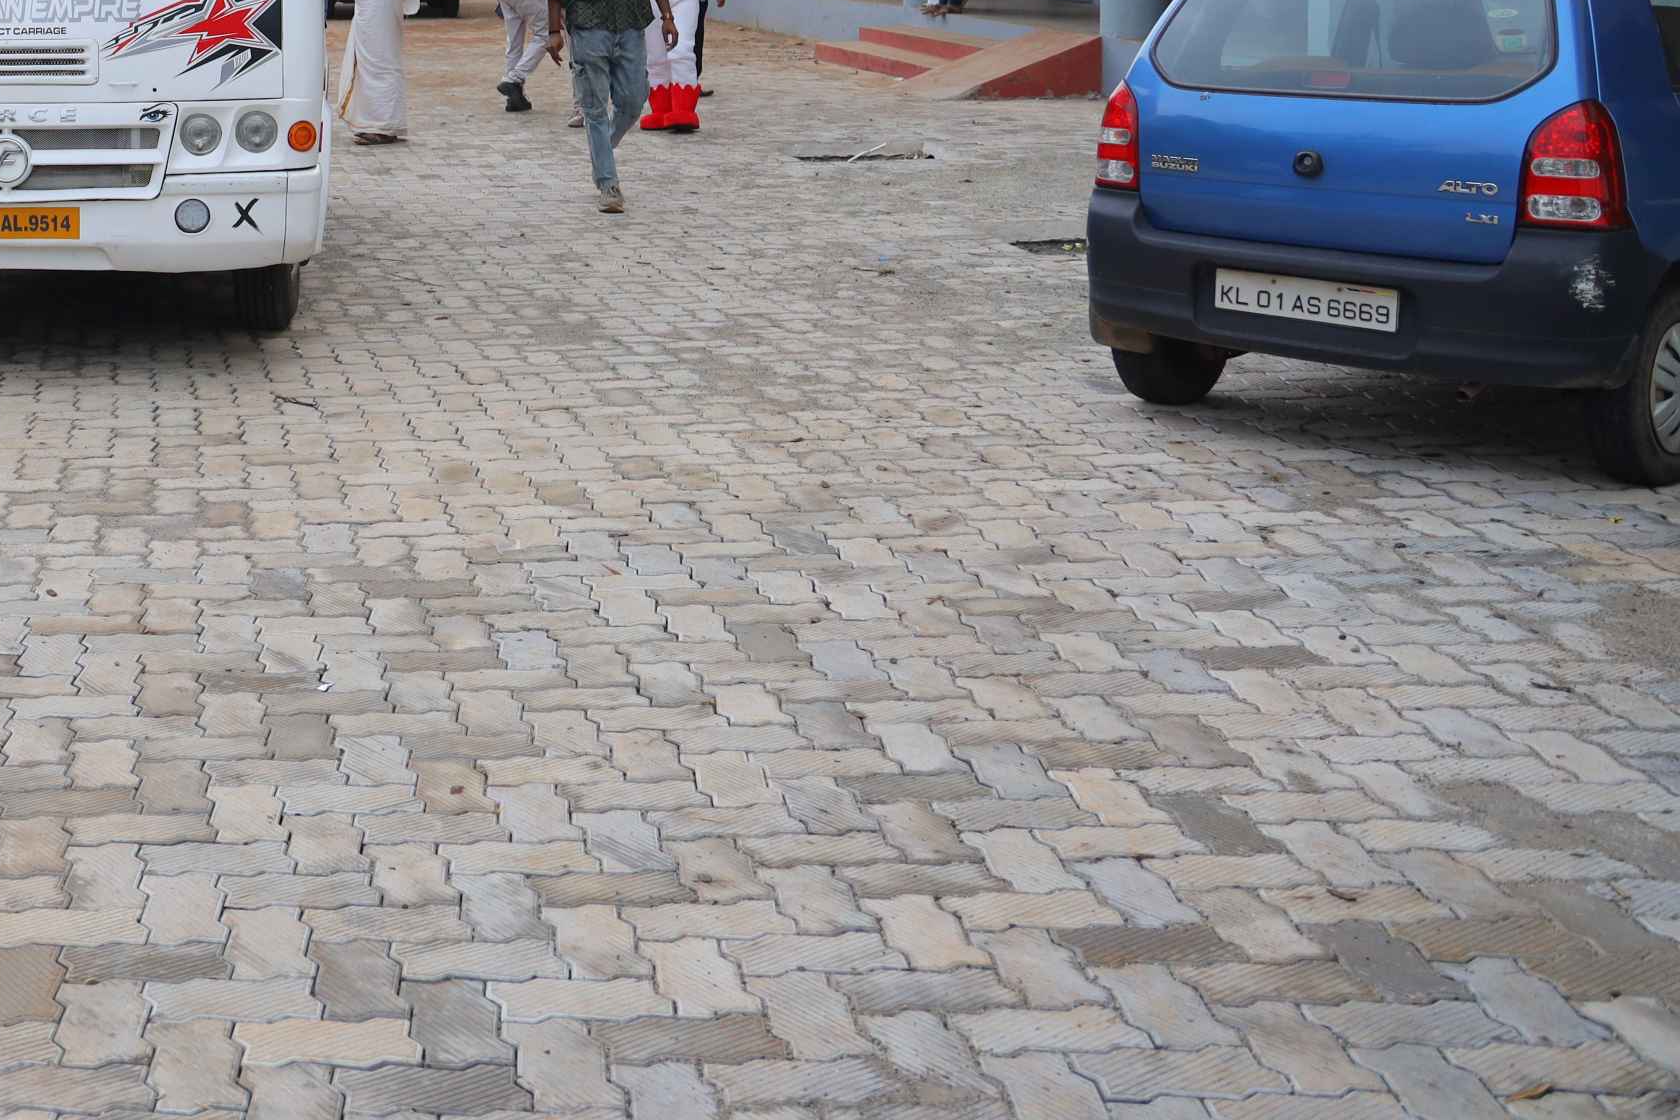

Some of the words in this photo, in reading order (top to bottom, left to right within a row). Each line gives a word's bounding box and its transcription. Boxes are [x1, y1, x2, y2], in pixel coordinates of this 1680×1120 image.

[13, 26, 67, 35] CARRIAGE
[1151, 161, 1199, 172] SUZUKI
[1437, 180, 1499, 196] ALTO
[1220, 284, 1249, 306] KL
[1256, 289, 1284, 310] 01
[1291, 295, 1321, 315] AS
[1327, 299, 1390, 324] 6669
